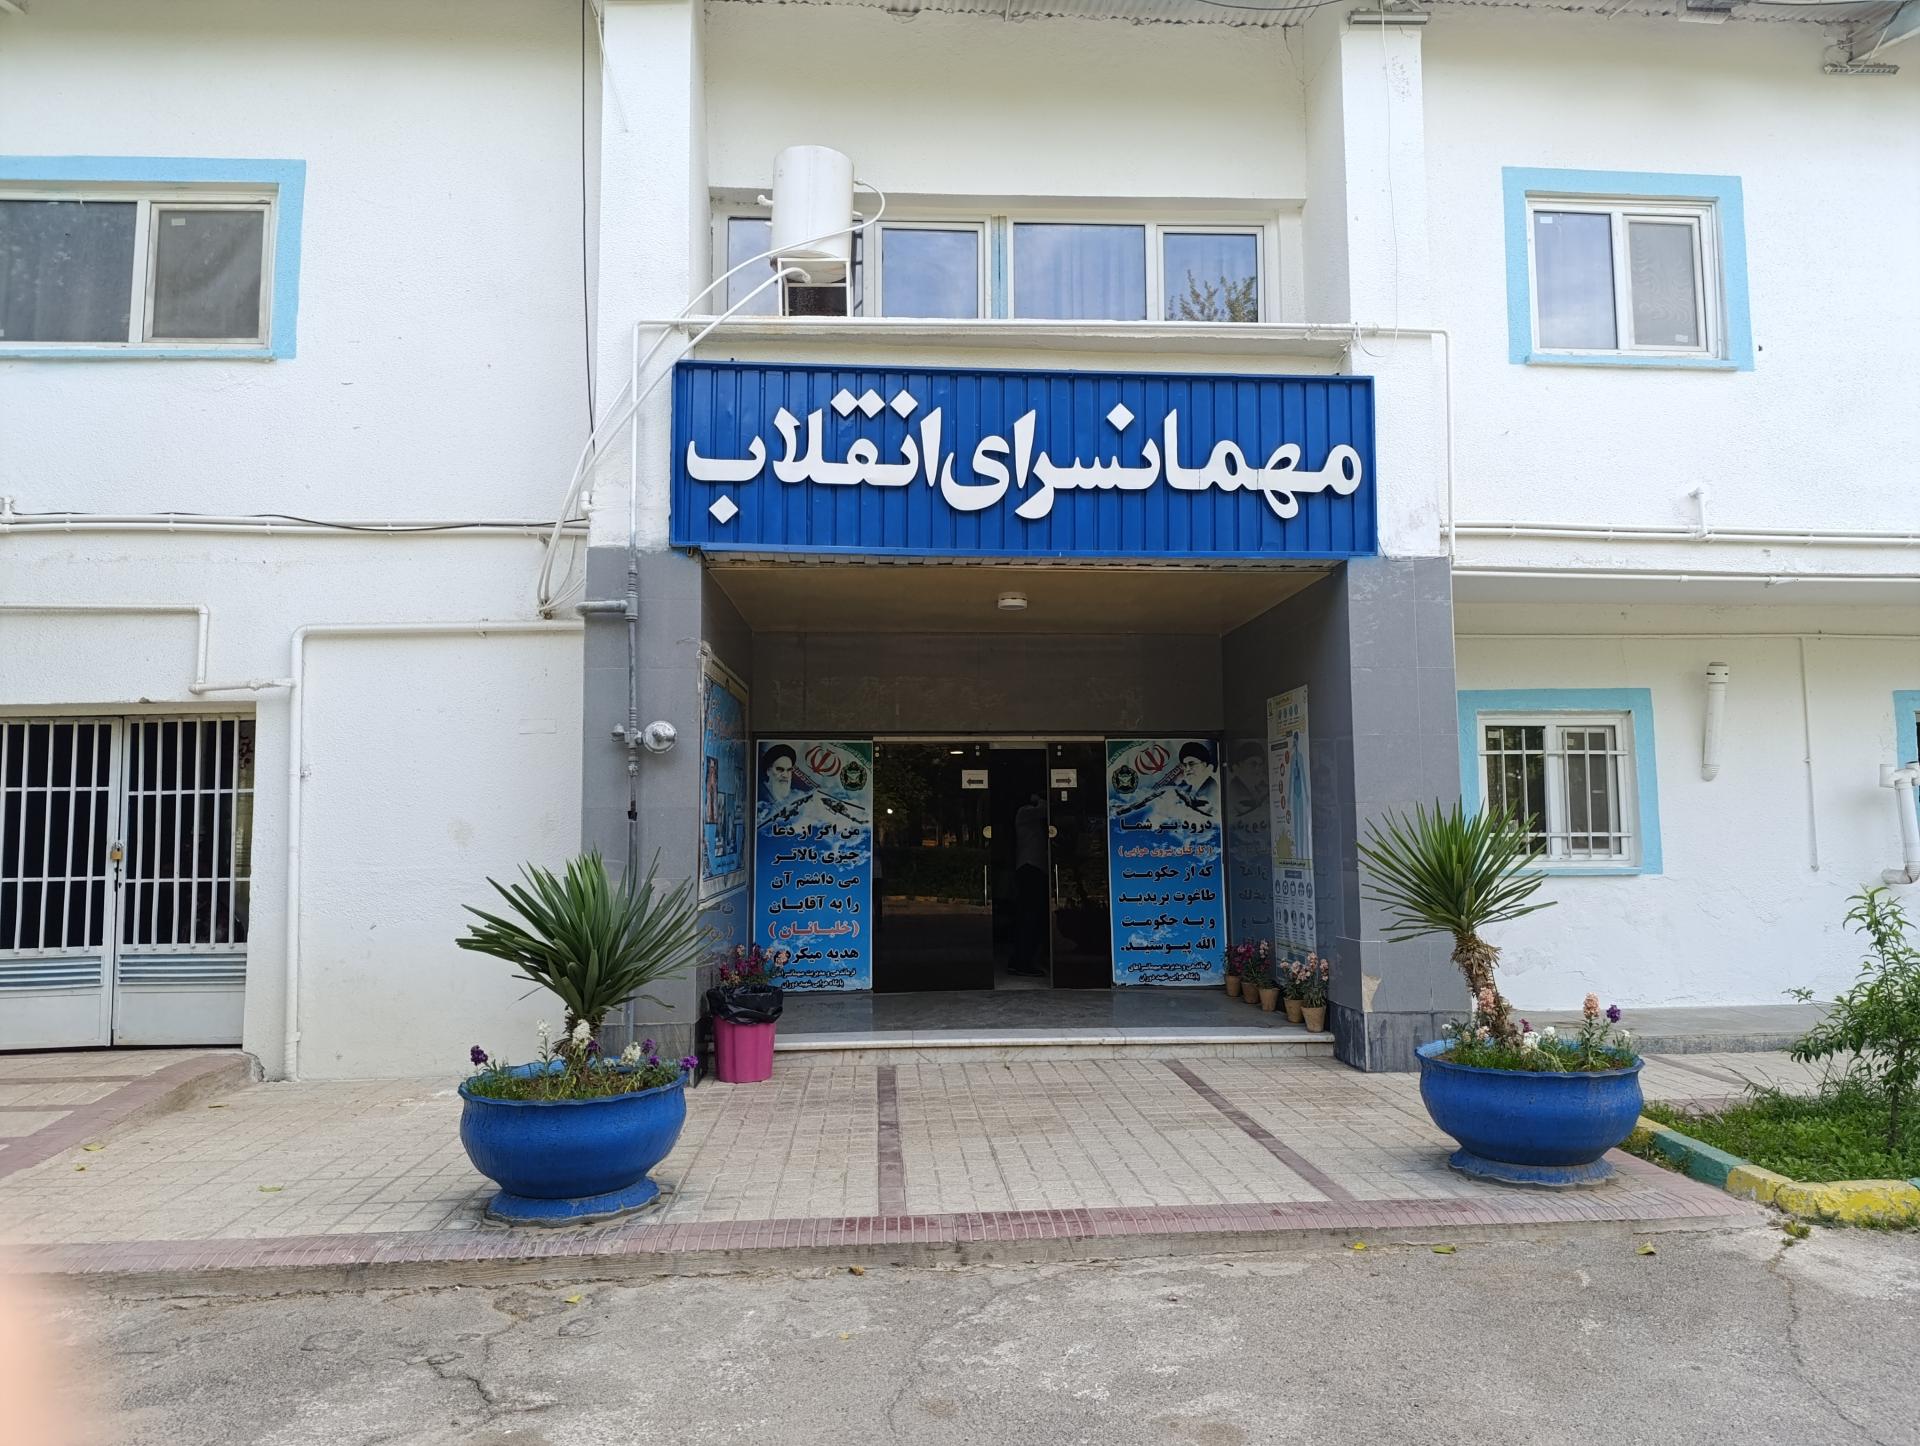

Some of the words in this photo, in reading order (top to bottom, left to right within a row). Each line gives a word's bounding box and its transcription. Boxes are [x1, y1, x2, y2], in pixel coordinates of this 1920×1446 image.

[686, 388, 942, 525] انقلاب
[941, 402, 1363, 519] مهمانسرای
[772, 823, 796, 836] دعا
[799, 823, 812, 840] از
[1119, 817, 1153, 832] شما
[1158, 821, 1178, 834] بر
[1182, 819, 1213, 834] درود
[840, 827, 860, 840] من
[772, 847, 818, 865] بالاتر
[822, 850, 860, 864] چیزی
[1122, 865, 1179, 882] حکومت
[1184, 863, 1196, 882] از
[1198, 865, 1213, 878] که
[771, 871, 792, 889] آن
[796, 872, 834, 889] داشتم
[838, 876, 860, 889] می
[769, 895, 826, 914] آقایان
[846, 896, 860, 913] را
[1118, 892, 1170, 906] بریدید
[1173, 888, 1216, 906] طاغوت
[829, 897, 842, 913] به
[1121, 913, 1178, 930] حکومت
[1182, 916, 1205, 929] به
[1209, 917, 1216, 929] و
[1195, 935, 1216, 950] الله
[826, 948, 859, 962] هدیه
